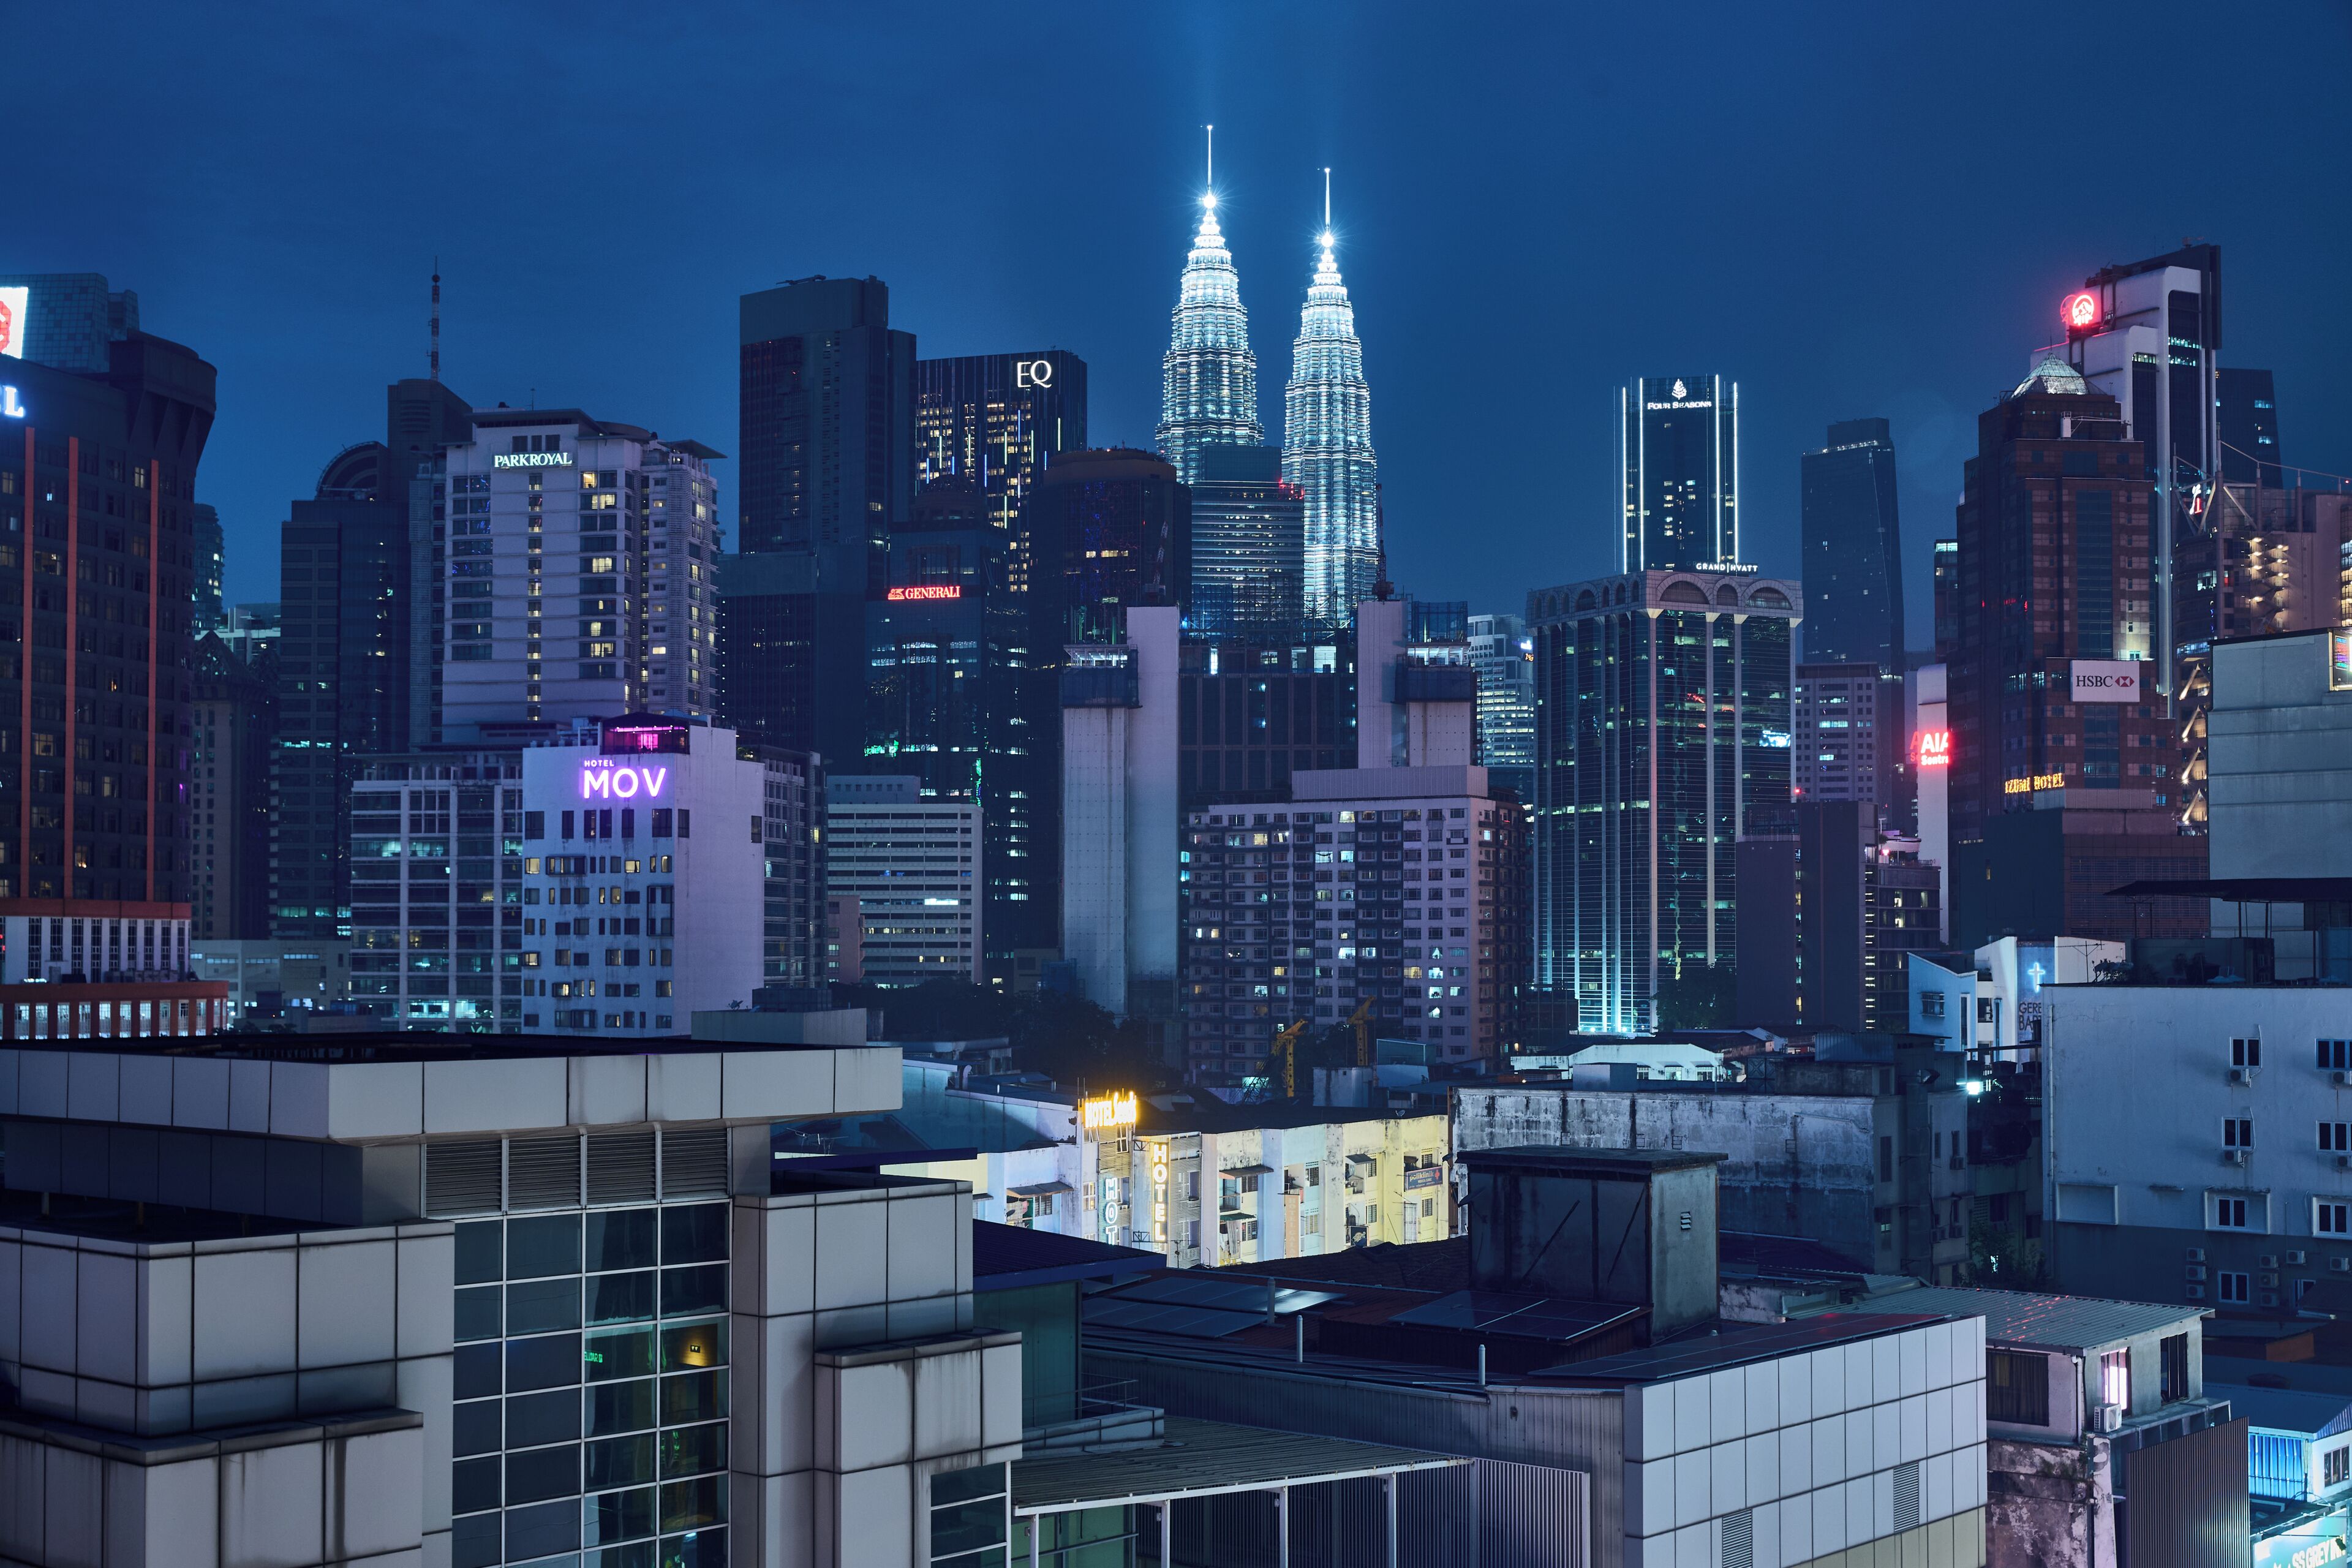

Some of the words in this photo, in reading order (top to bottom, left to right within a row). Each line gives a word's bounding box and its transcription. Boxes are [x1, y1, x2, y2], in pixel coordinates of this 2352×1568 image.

[1017, 360, 1052, 388] EQ
[1672, 401, 1711, 409] SEASONS
[494, 452, 572, 467] PARKROYAL
[905, 586, 960, 599] GENERALI
[2076, 676, 2113, 687] HSBC
[584, 767, 666, 799] MOV
[2034, 772, 2065, 790] HOTEL
[1085, 1100, 1112, 1128] HOTEL
[1410, 1170, 1433, 1182] poliklinik
[1153, 1144, 1167, 1241] HOTEL
[2305, 1539, 2330, 1568] GREY
